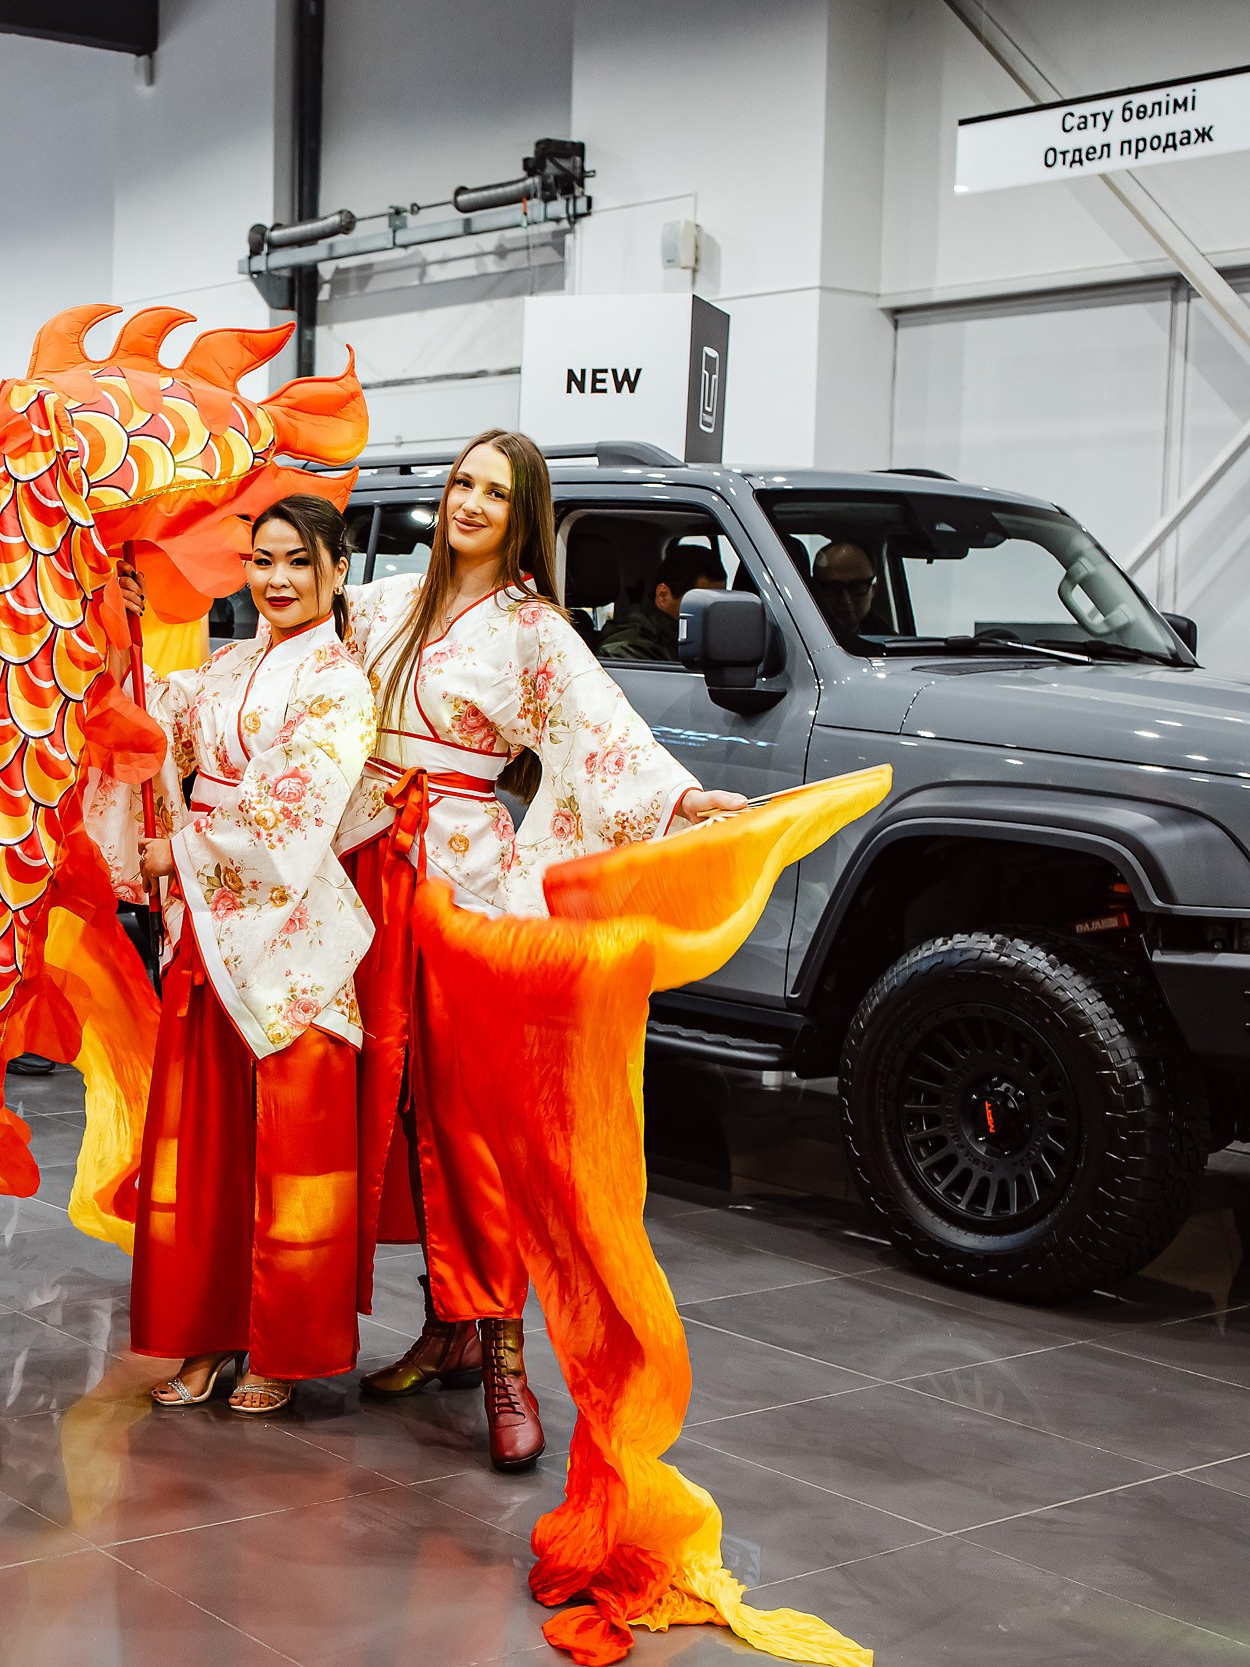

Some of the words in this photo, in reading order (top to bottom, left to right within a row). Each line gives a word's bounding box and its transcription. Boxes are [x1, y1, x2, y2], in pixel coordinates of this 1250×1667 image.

[1061, 109, 1114, 133] Сату
[1121, 89, 1197, 123] бөлімі
[1044, 143, 1111, 168] Отдел
[1119, 125, 1215, 159] продаж
[566, 368, 643, 394] NEW
